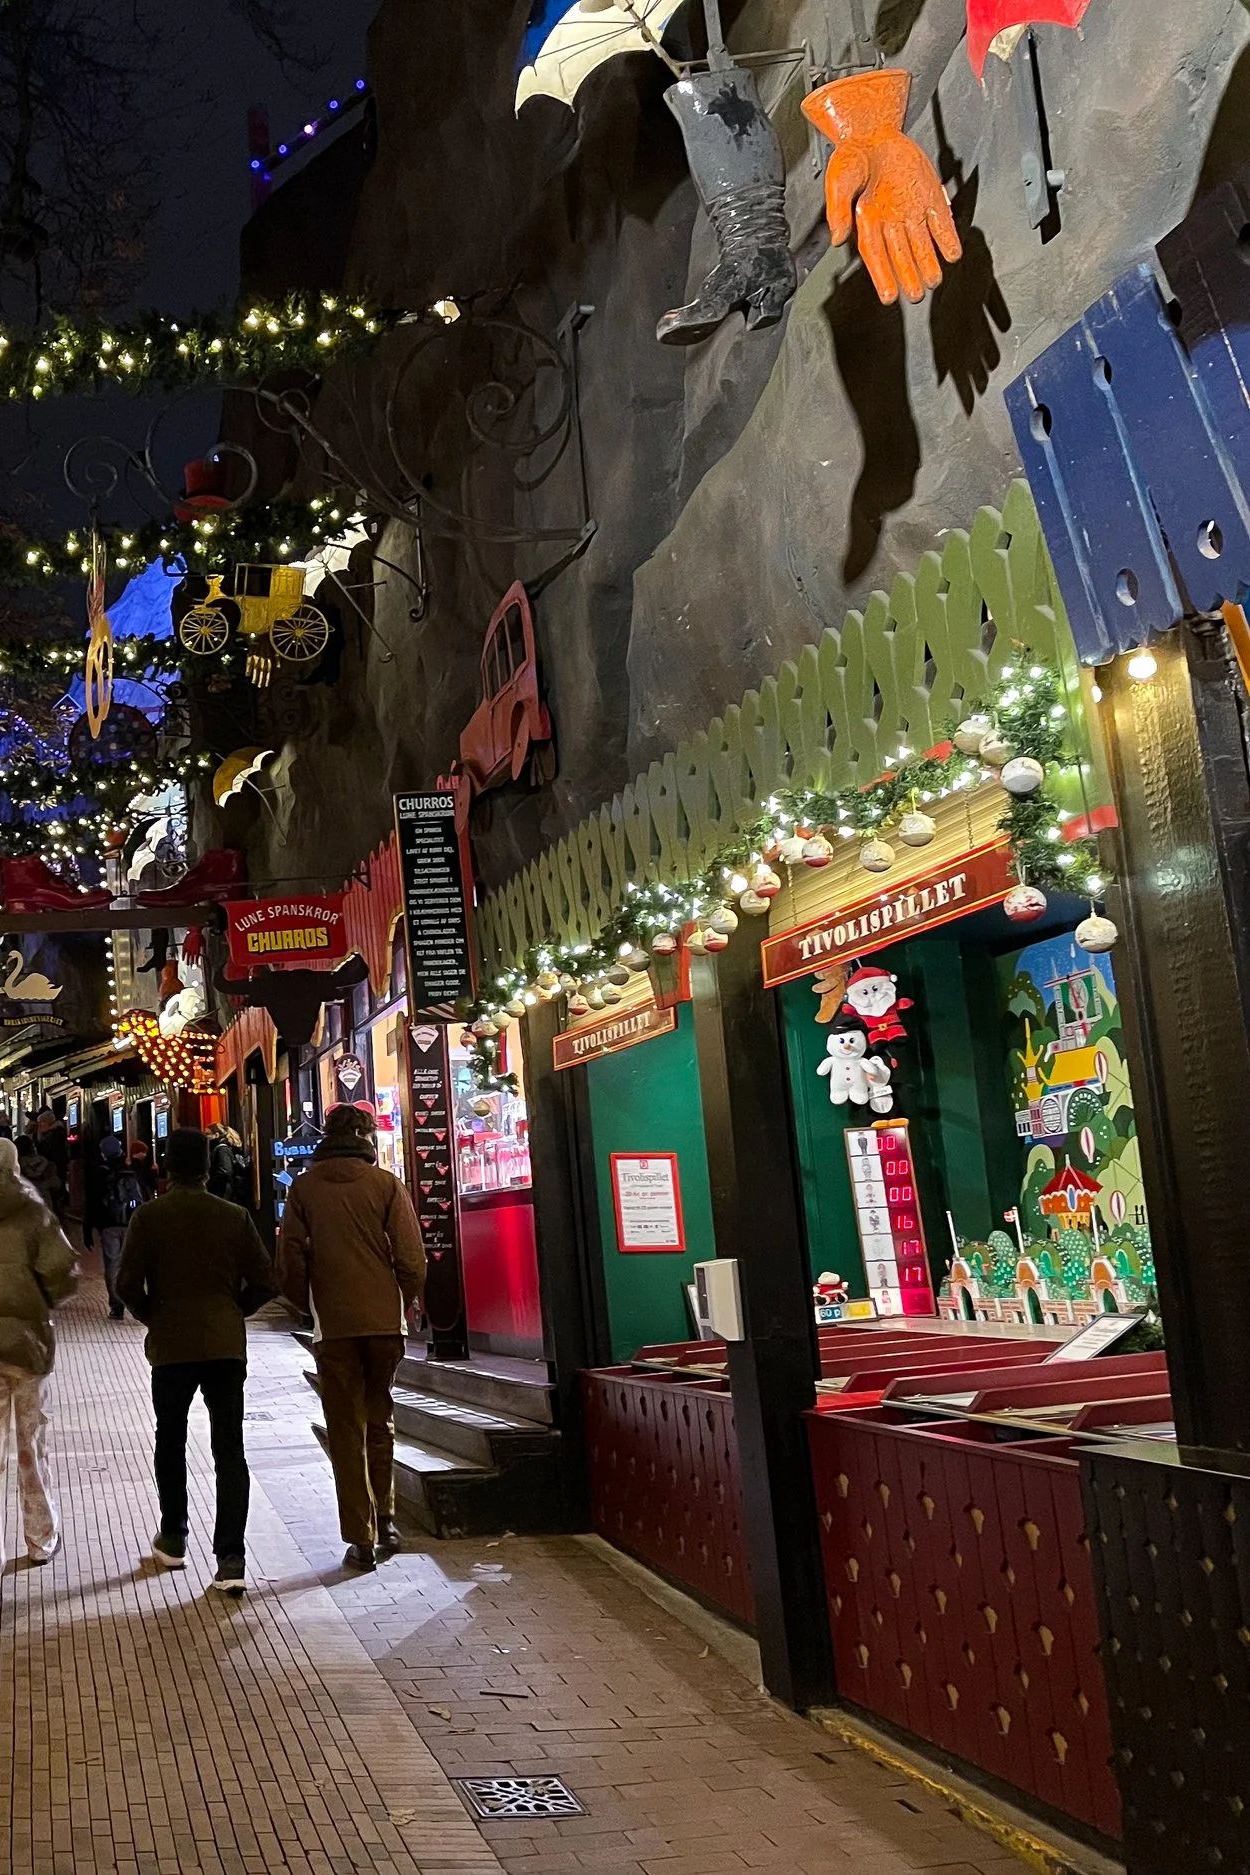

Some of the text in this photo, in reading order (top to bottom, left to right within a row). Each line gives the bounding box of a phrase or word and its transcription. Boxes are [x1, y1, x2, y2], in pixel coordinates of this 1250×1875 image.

[398, 796, 454, 810] CHURROS
[235, 910, 265, 932] LUNE
[798, 873, 967, 960] TIVOLISPILLET
[247, 927, 328, 953] CHURROS
[572, 1010, 651, 1055] TIVOLISPILLET
